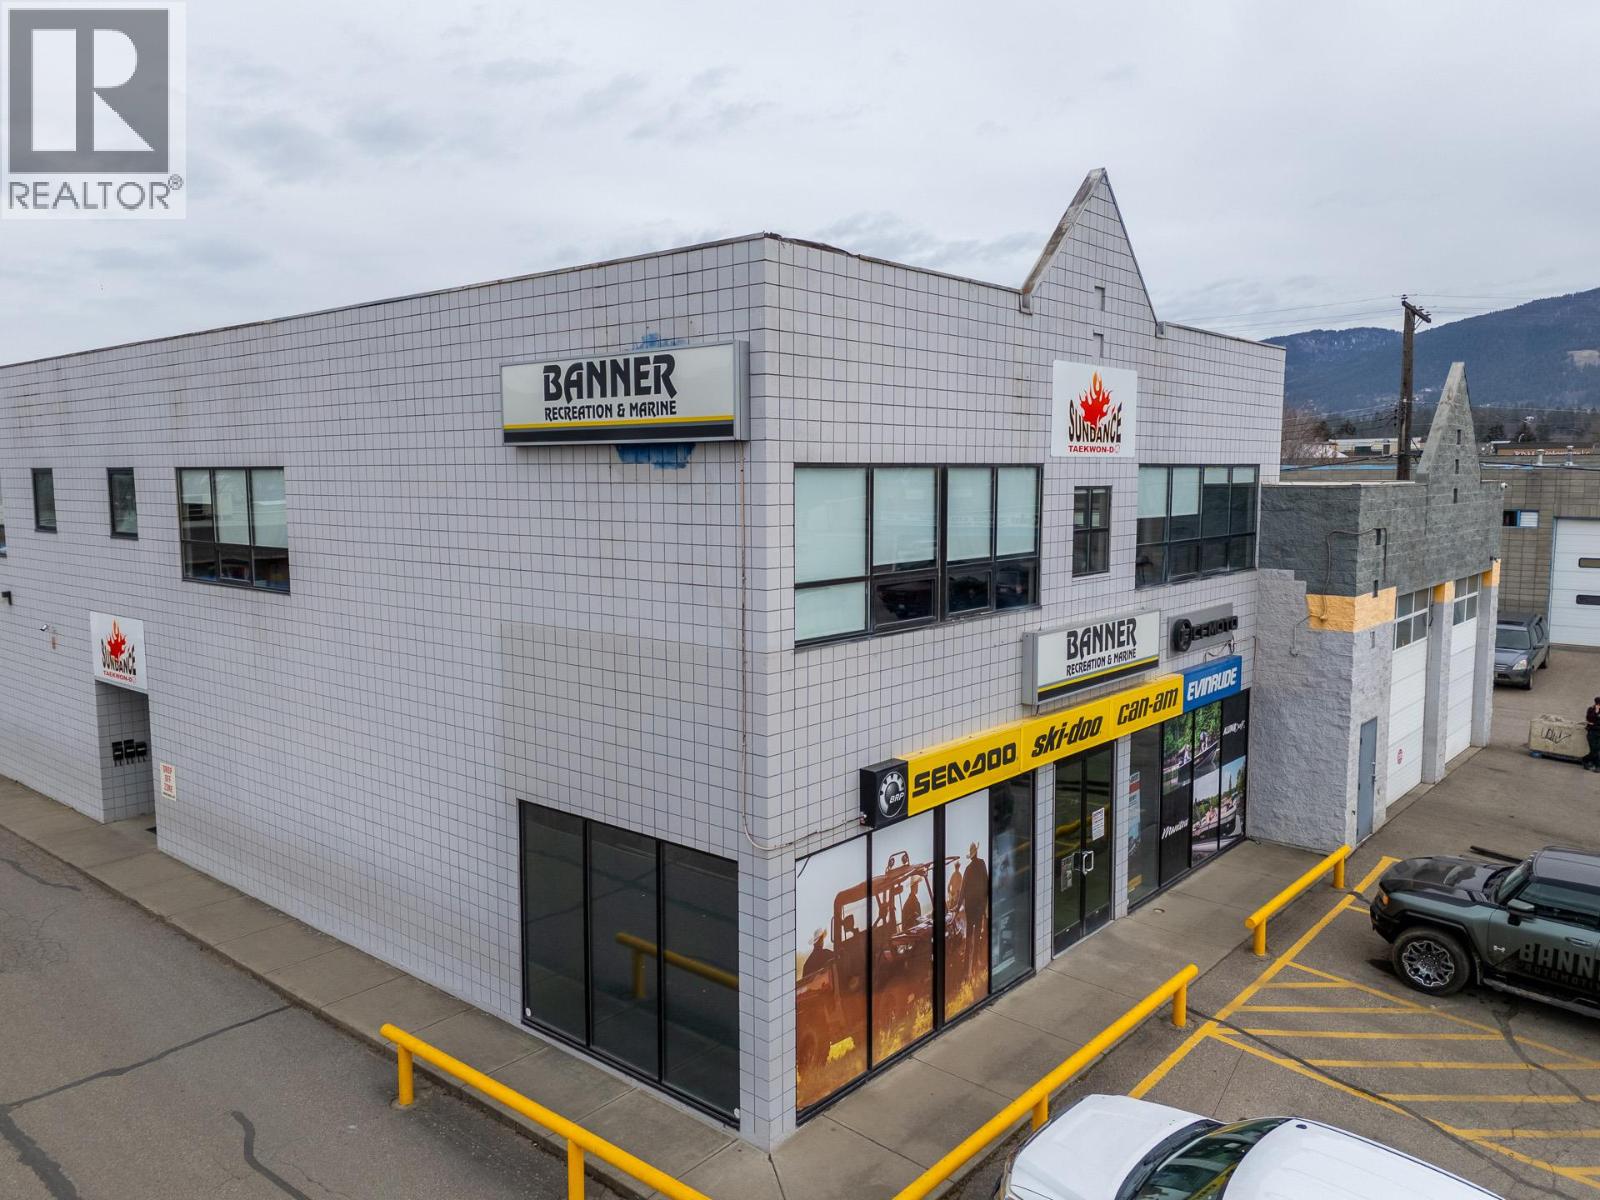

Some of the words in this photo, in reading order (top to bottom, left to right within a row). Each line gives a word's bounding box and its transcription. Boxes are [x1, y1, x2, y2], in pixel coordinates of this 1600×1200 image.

[543, 354, 677, 404] BANNER
[544, 403, 613, 421] RECREATION
[617, 403, 625, 418] &
[629, 400, 677, 418] MARINE
[1068, 400, 1122, 443] SUNDANCE
[1066, 617, 1137, 660] BANNER
[1066, 657, 1106, 676] RECREATION
[1107, 653, 1113, 665] &
[1113, 648, 1137, 664] MARINE
[1186, 667, 1238, 701] EVINRUDE
[1117, 687, 1179, 726] can-am
[1031, 715, 1104, 757] ski-doo
[890, 792, 905, 804] BRP
[1519, 943, 1600, 984] BANN
